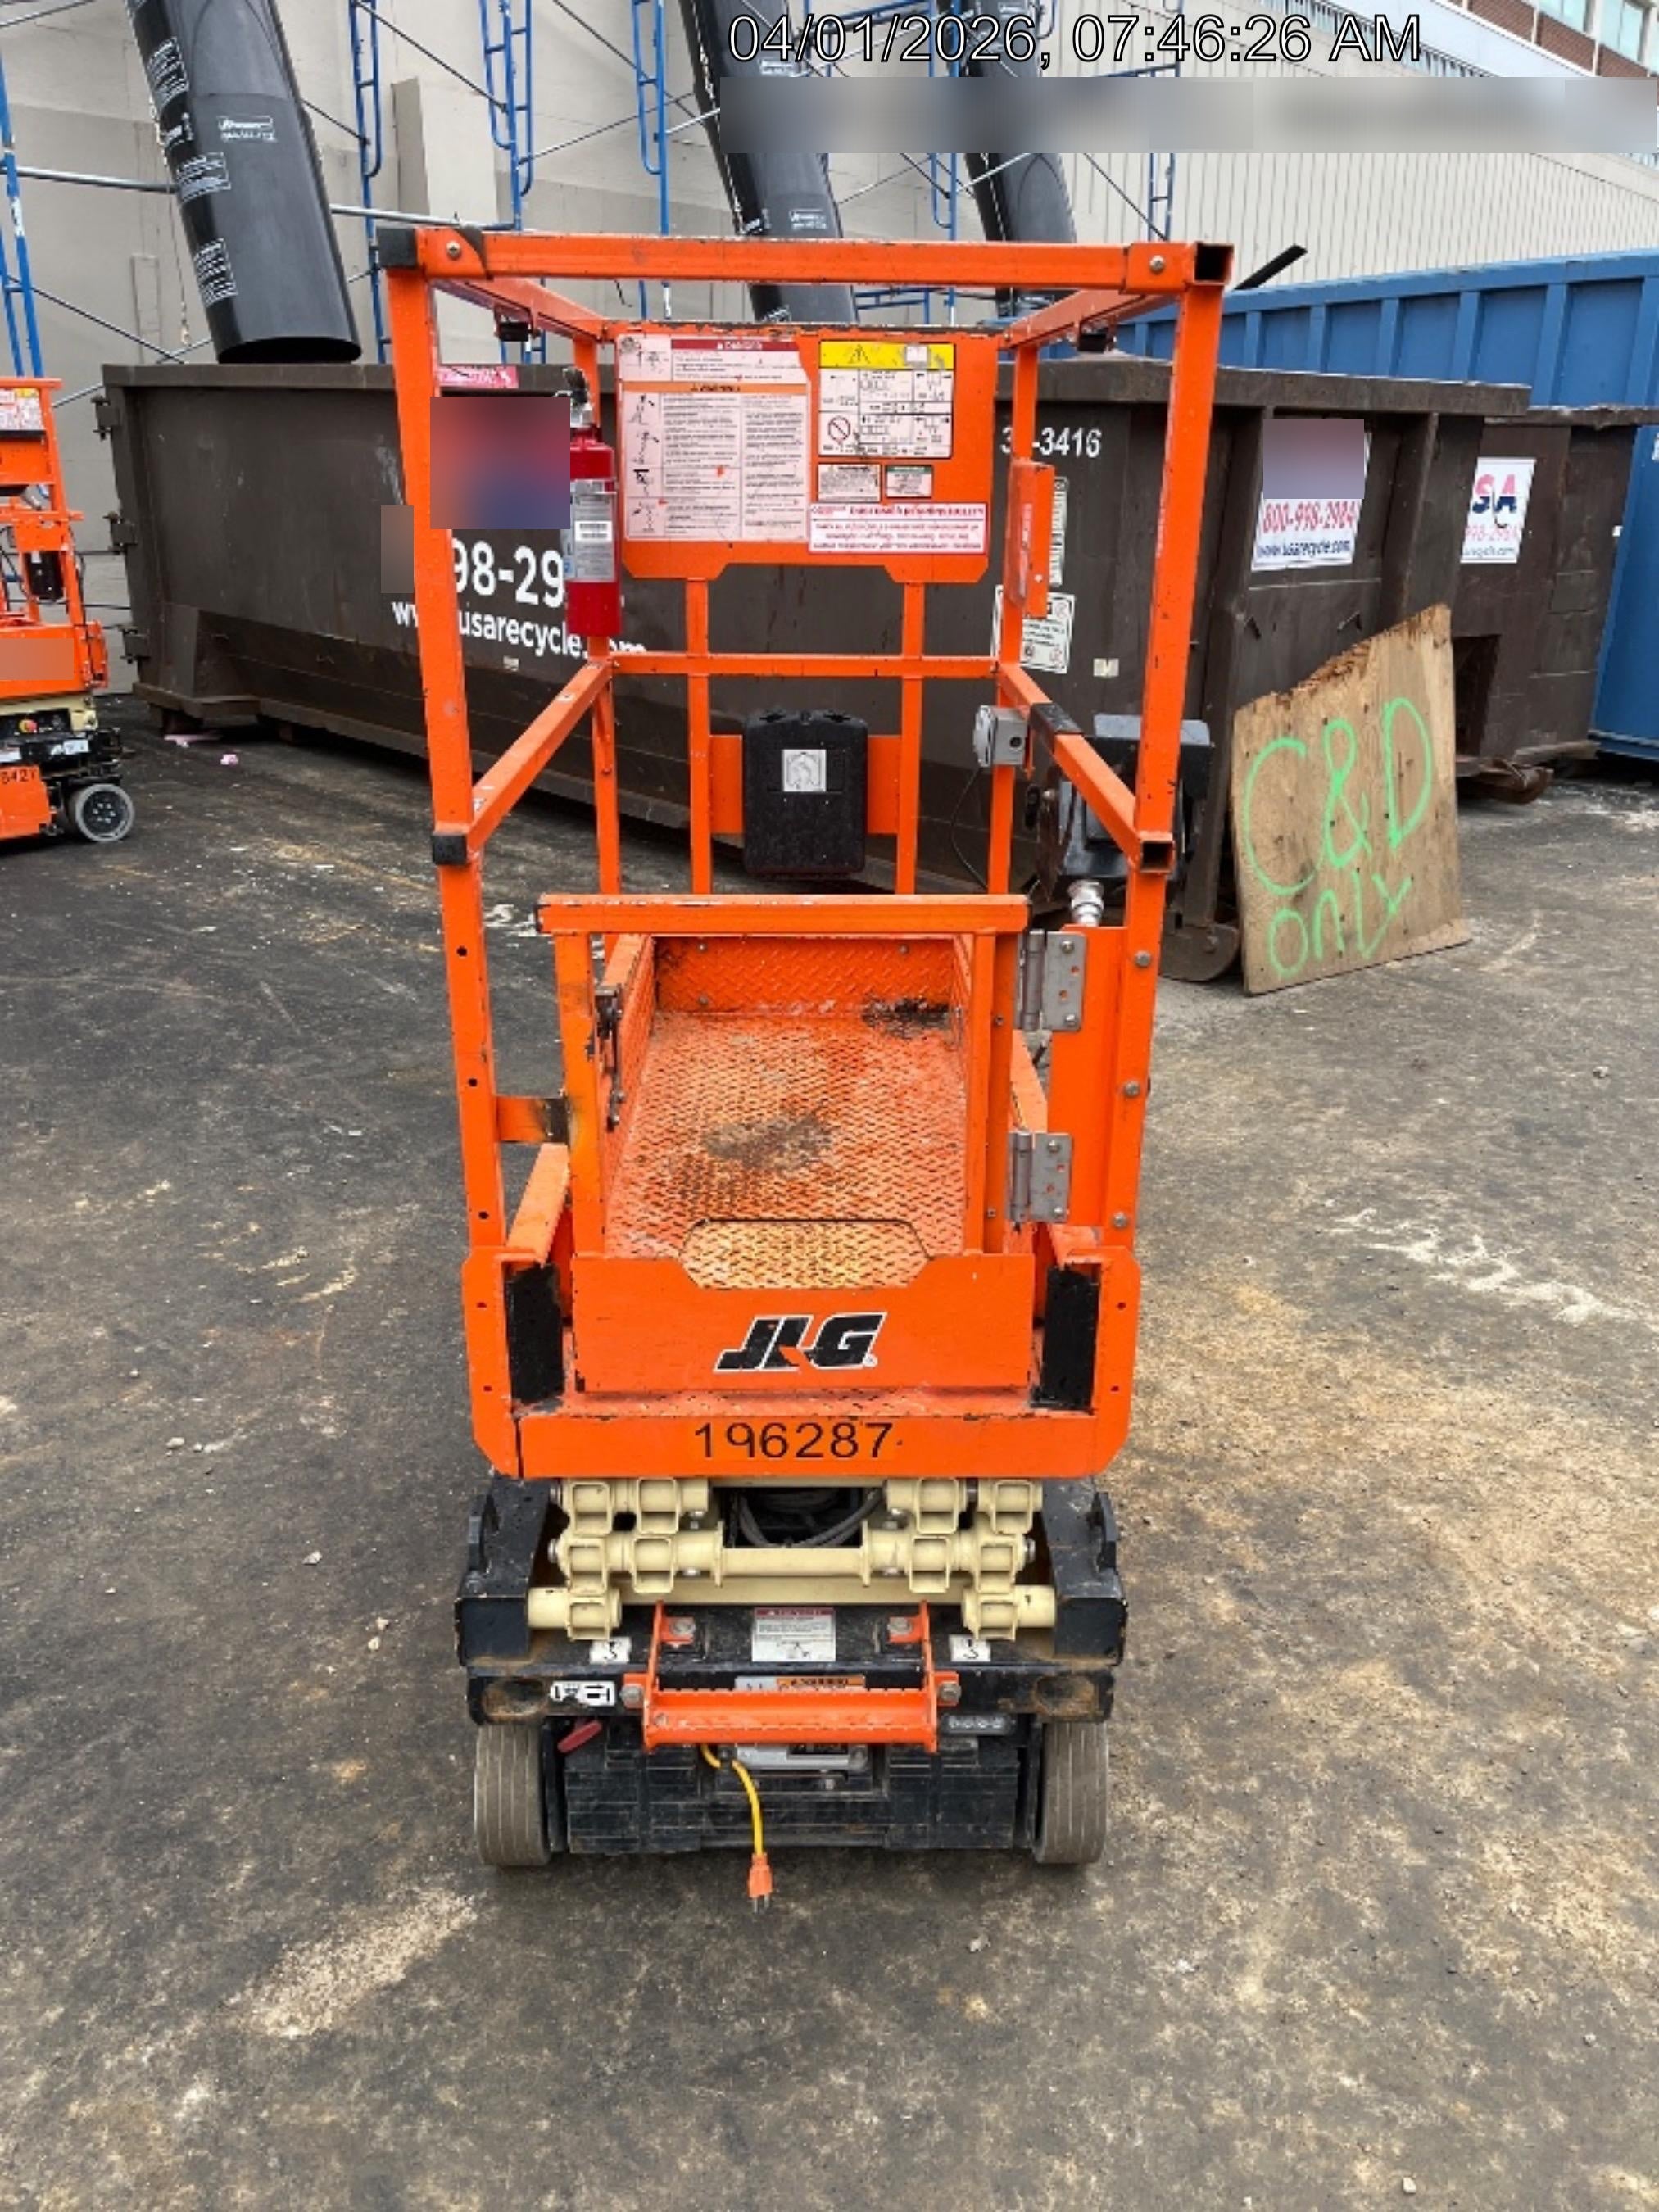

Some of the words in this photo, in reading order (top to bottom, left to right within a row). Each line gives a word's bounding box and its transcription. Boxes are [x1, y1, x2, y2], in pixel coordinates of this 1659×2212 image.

[1001, 426, 1102, 458] 3-3416
[1472, 473, 1518, 514] SA
[1242, 696, 1434, 896] C&D
[695, 1421, 893, 1458] 196287
